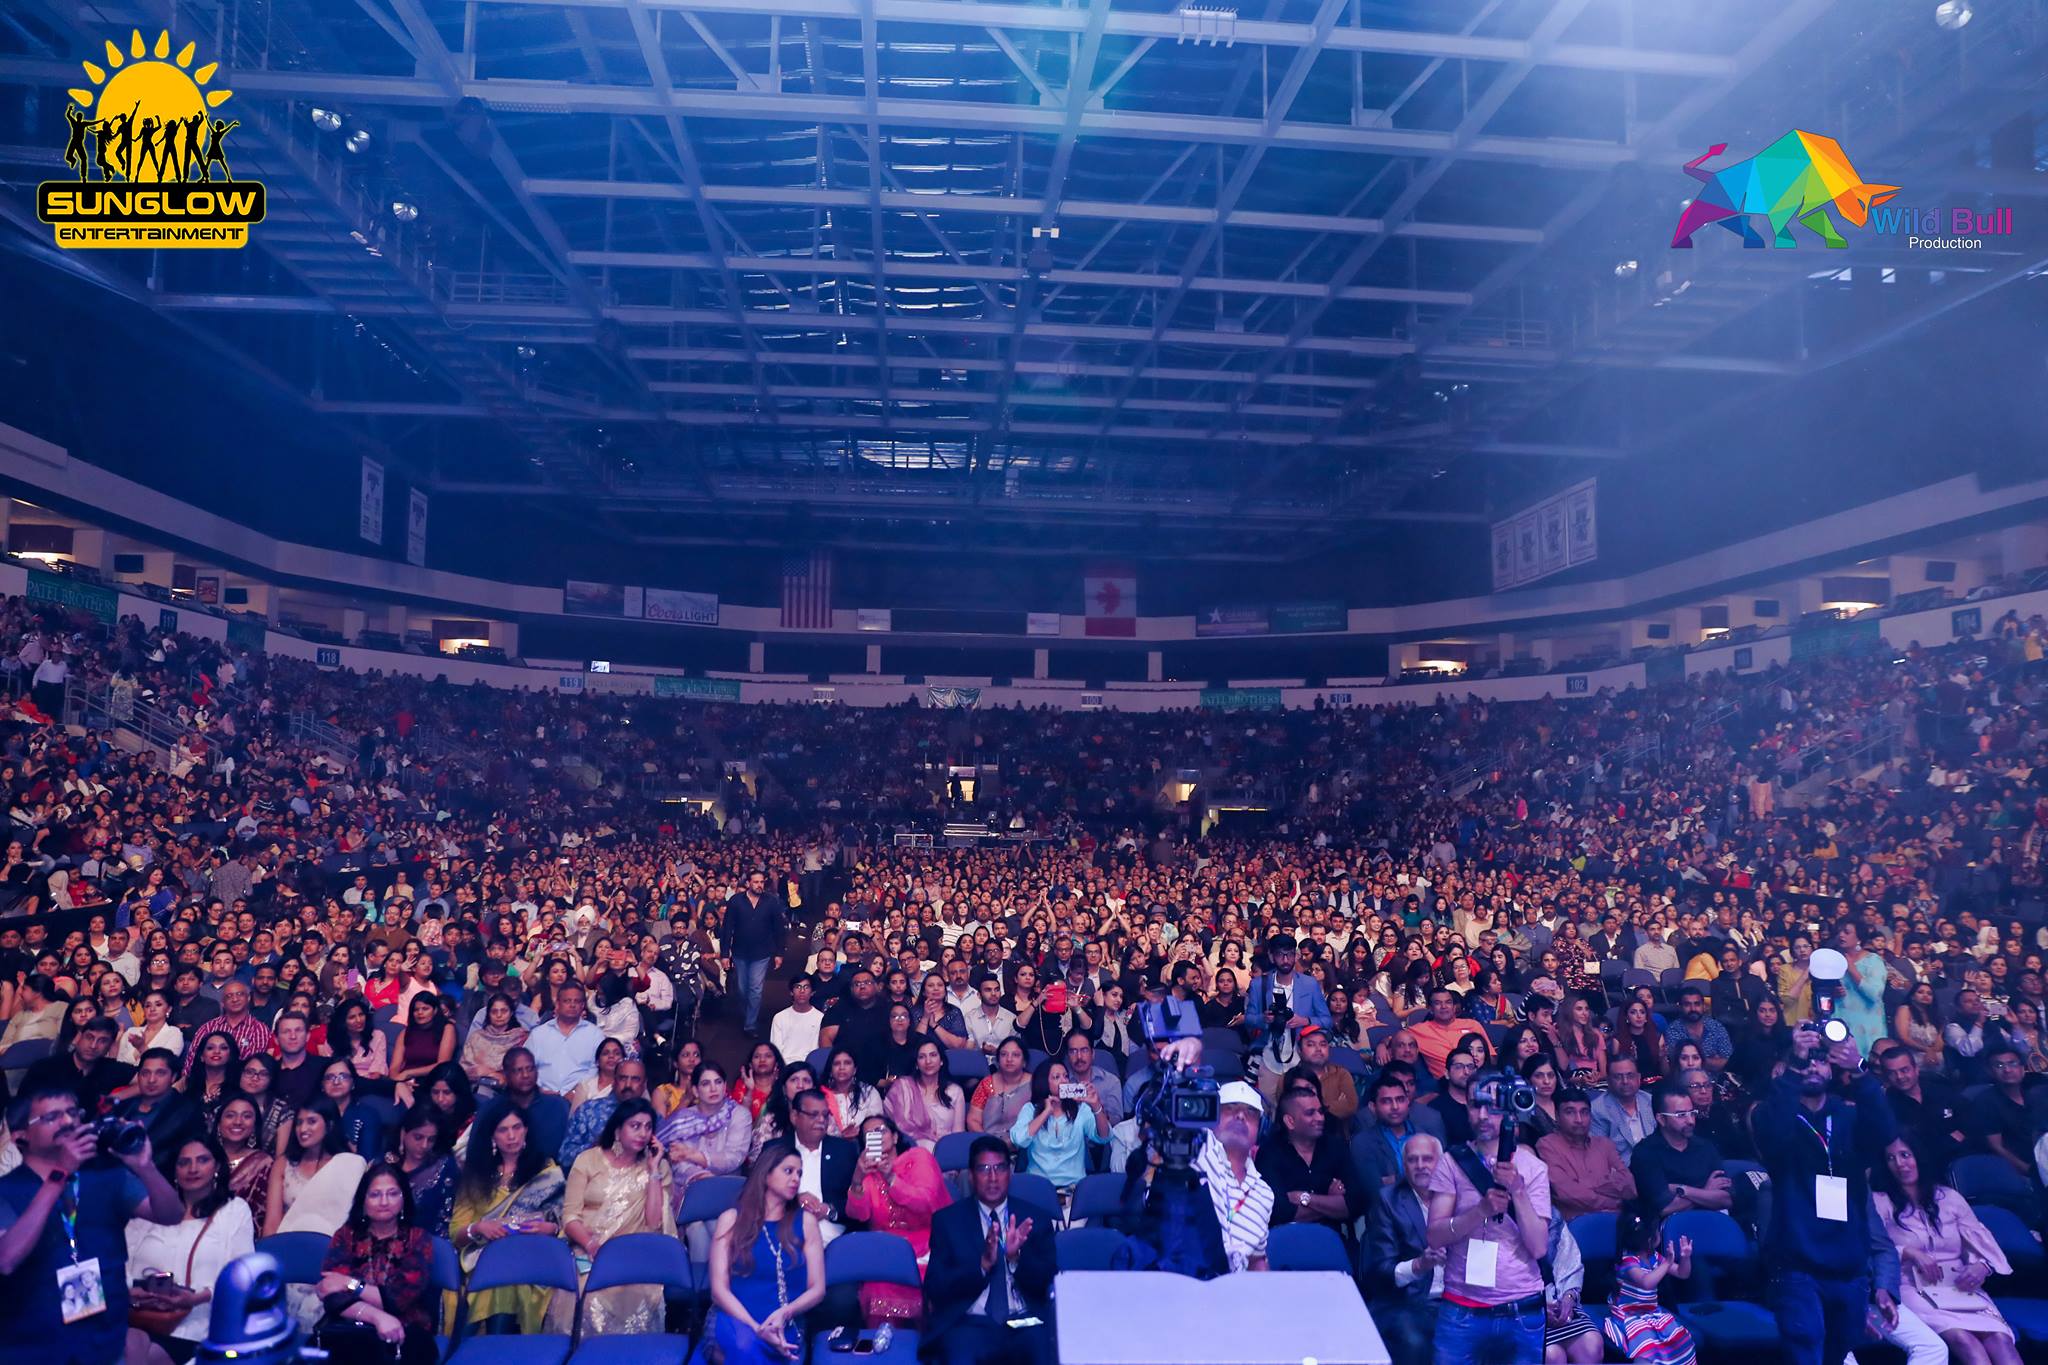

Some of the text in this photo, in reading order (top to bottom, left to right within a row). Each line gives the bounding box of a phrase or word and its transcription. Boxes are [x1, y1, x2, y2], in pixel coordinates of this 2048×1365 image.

[62, 590, 115, 617] BROTHERS
[648, 602, 683, 620] Coors
[684, 609, 716, 624] LIGHT
[320, 652, 337, 664] 118
[1569, 679, 1585, 690] 102
